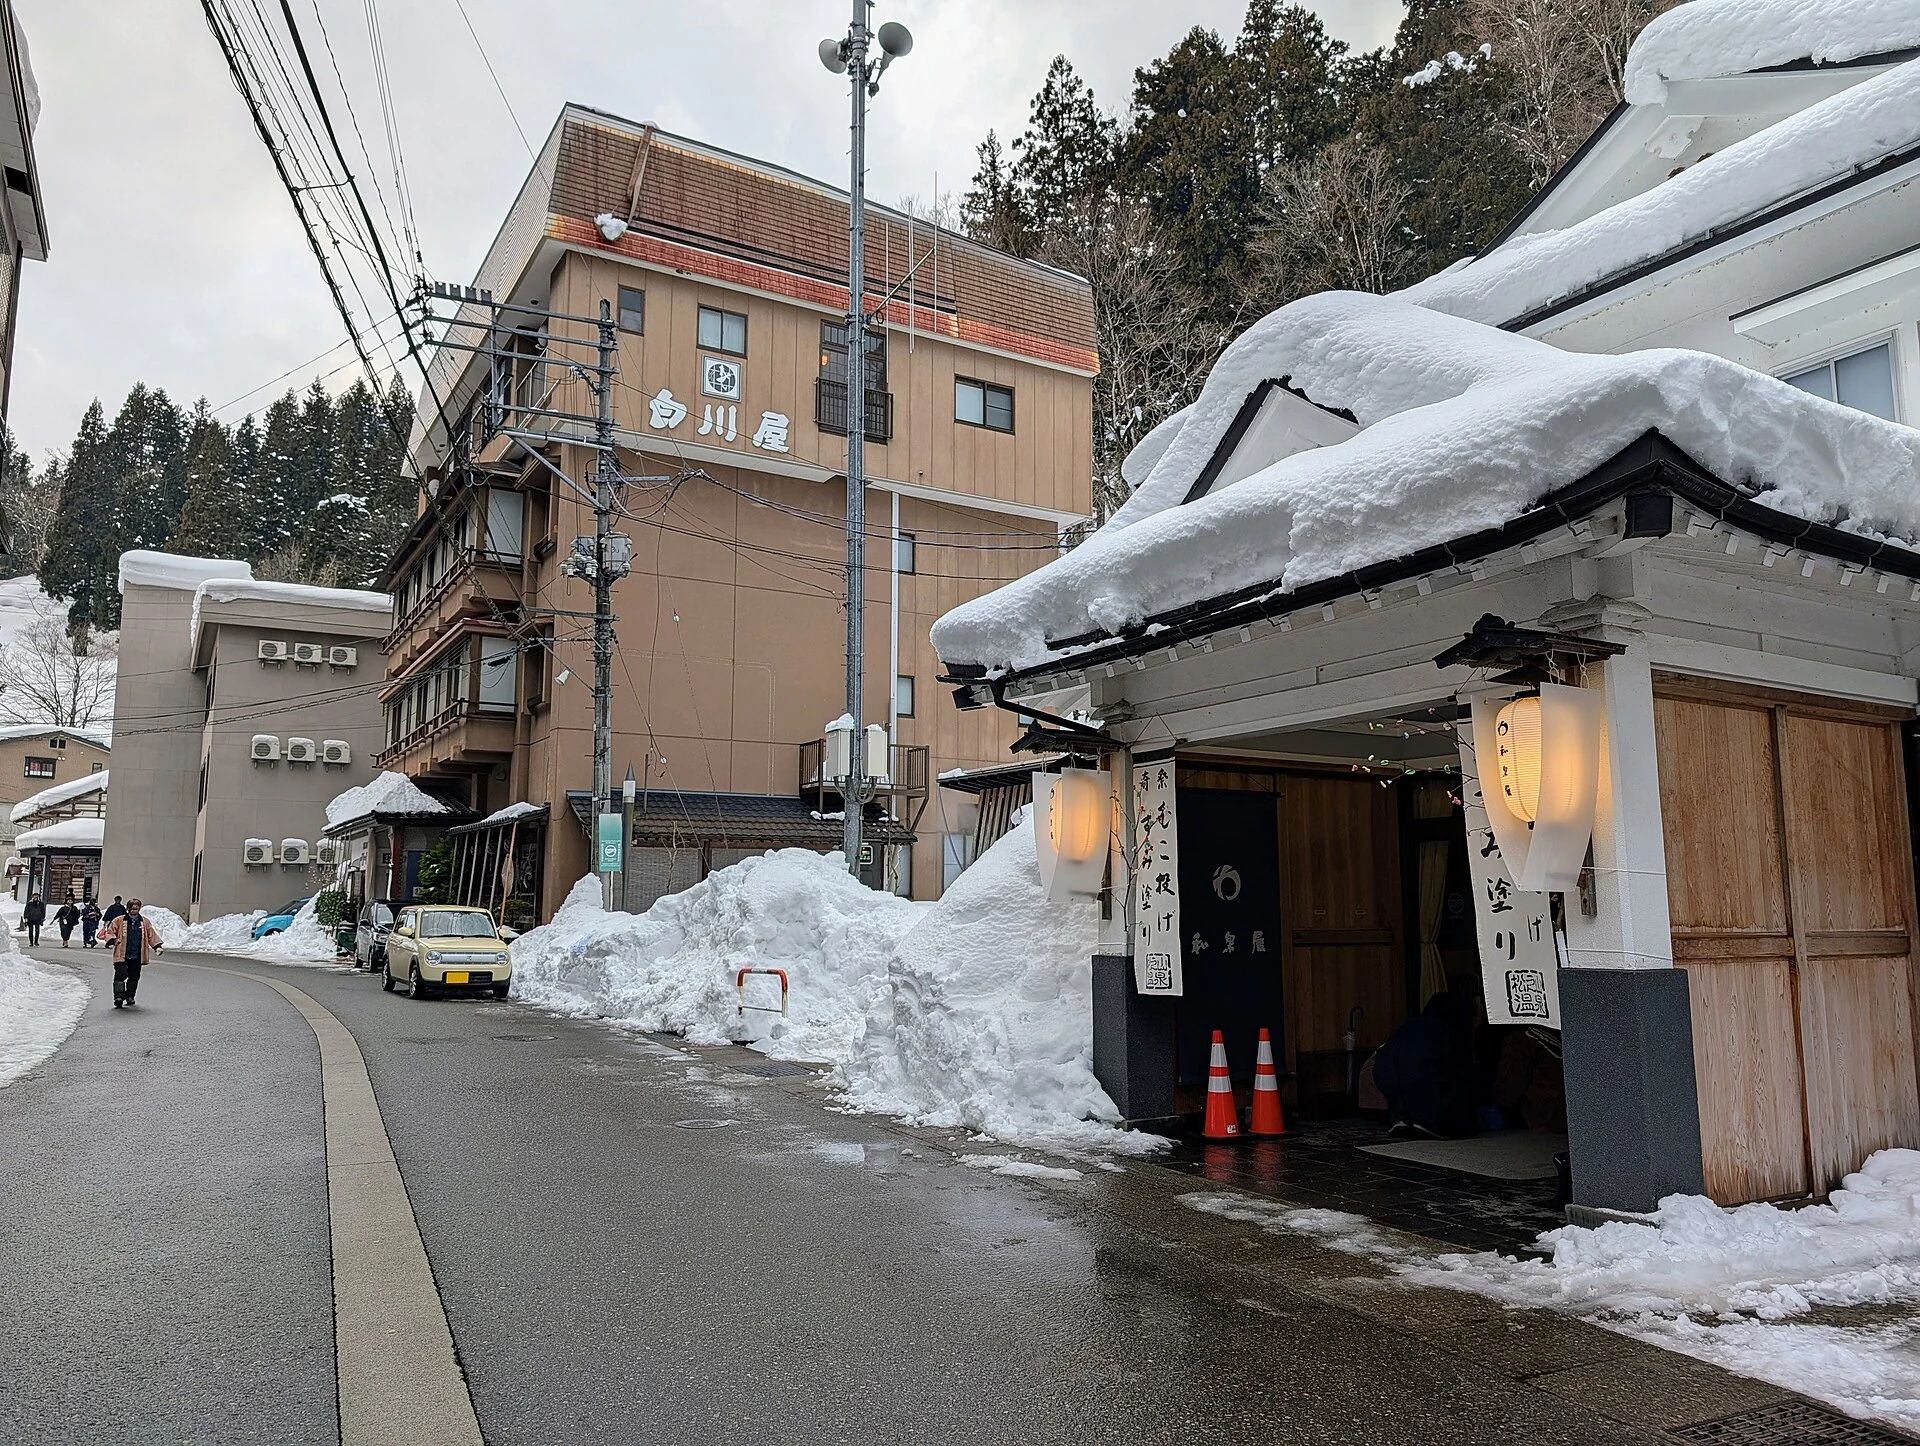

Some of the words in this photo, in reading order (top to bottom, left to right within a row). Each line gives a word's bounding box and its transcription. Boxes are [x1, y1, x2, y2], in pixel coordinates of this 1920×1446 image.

[649, 388, 790, 453] 白川屋
[1191, 930, 1267, 955] 和泉屋
